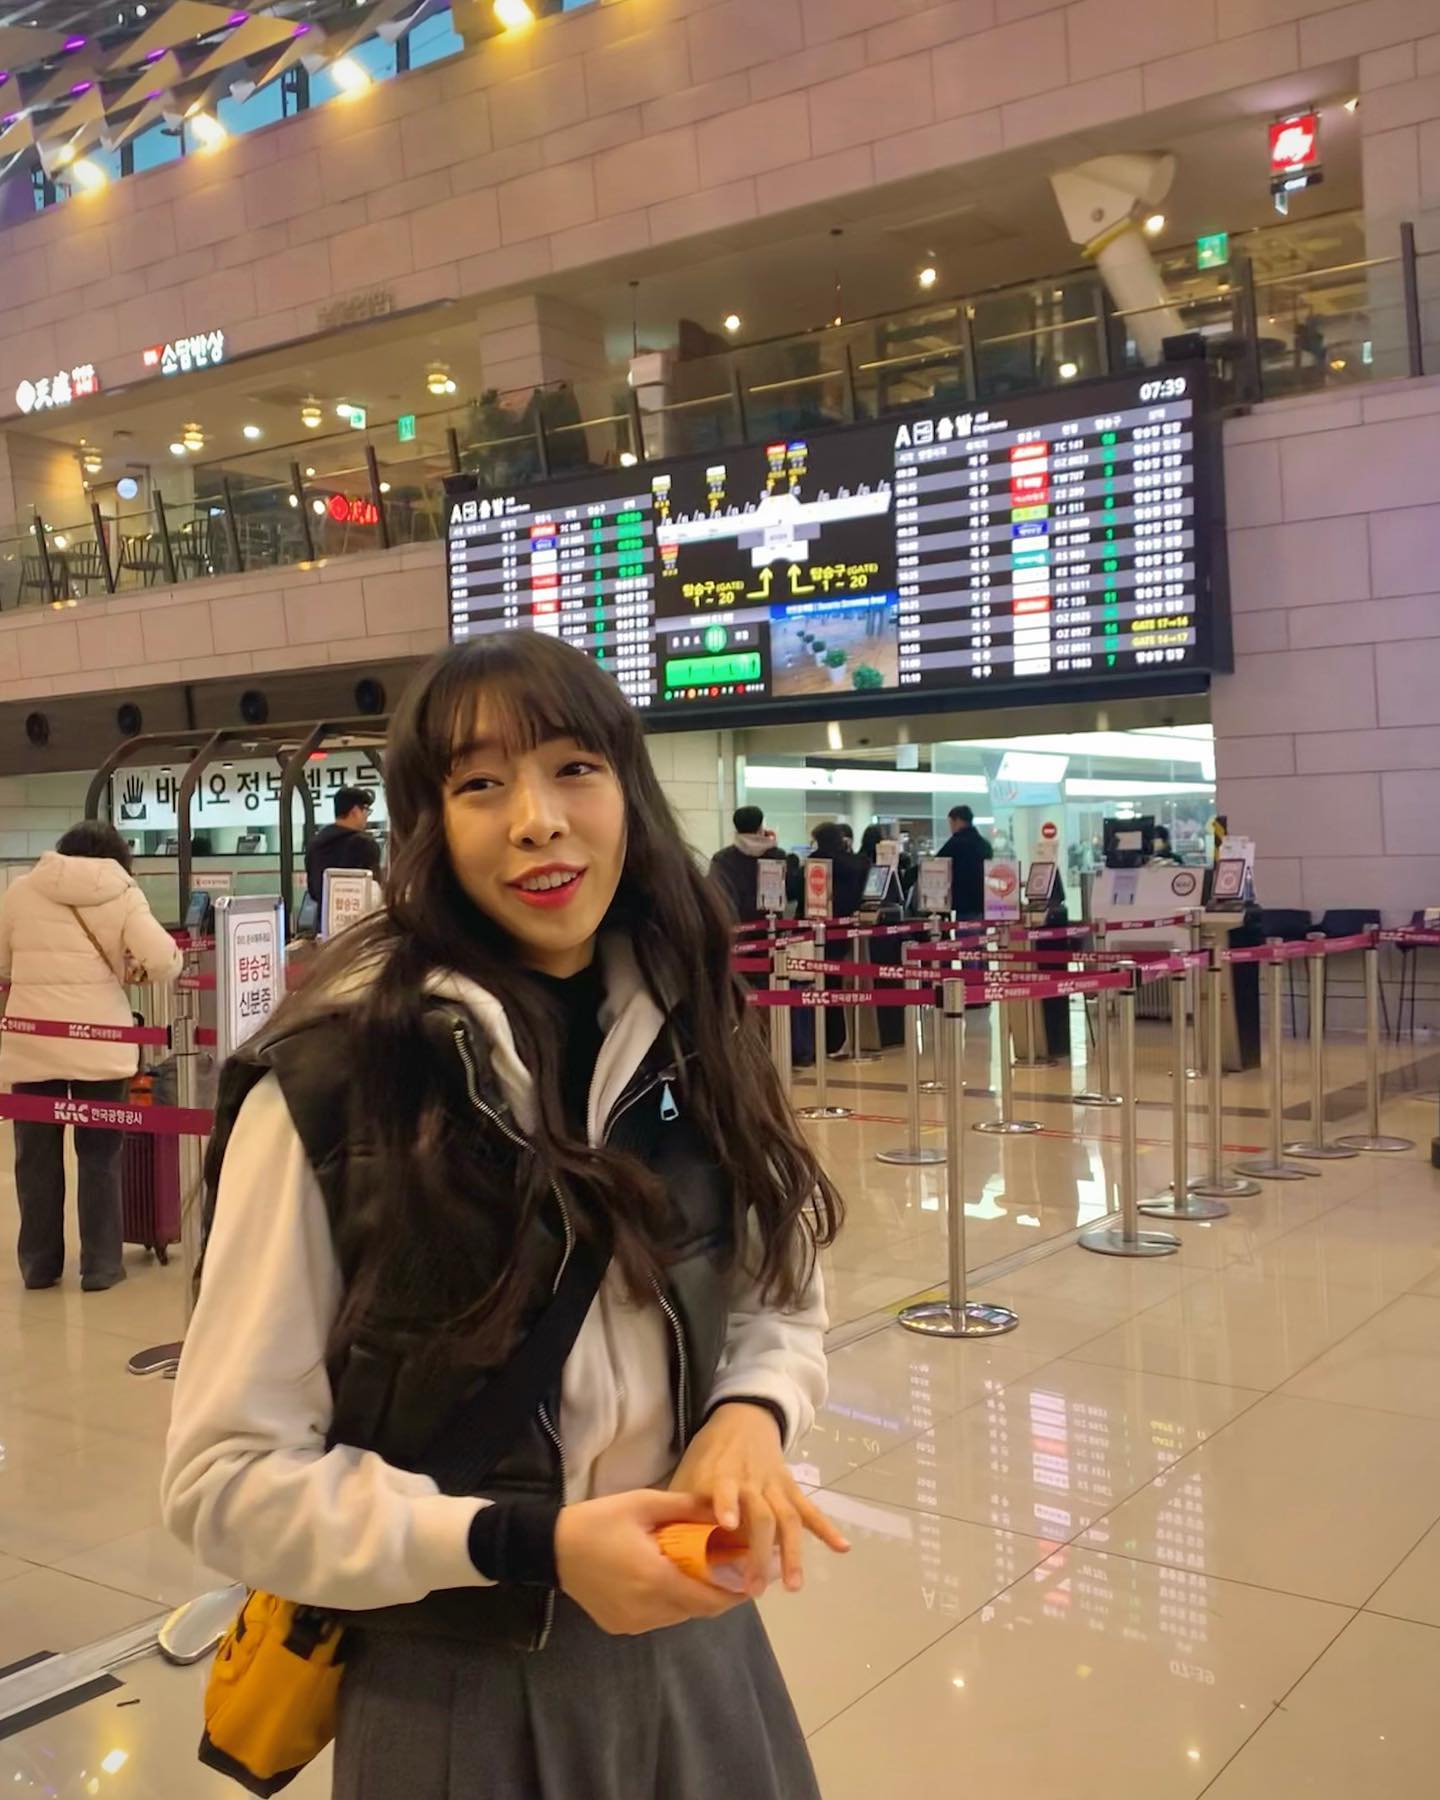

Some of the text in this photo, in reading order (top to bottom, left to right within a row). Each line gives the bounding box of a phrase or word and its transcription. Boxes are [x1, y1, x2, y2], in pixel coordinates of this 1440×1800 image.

[161, 329, 224, 374] 소담반상
[1140, 377, 1187, 400] 07:39
[895, 425, 911, 448] A
[451, 504, 462, 524] A
[850, 575, 868, 589] 20
[719, 591, 735, 604] 20
[959, 951, 980, 960] KAC
[239, 954, 271, 983] 탑승권
[879, 966, 904, 978] KAC
[984, 971, 1011, 982] KAC
[239, 988, 271, 1017] 신분증
[801, 992, 830, 1004] KAC
[68, 1024, 90, 1038] KAC
[54, 1101, 143, 1125] KAC 한국공항공사
